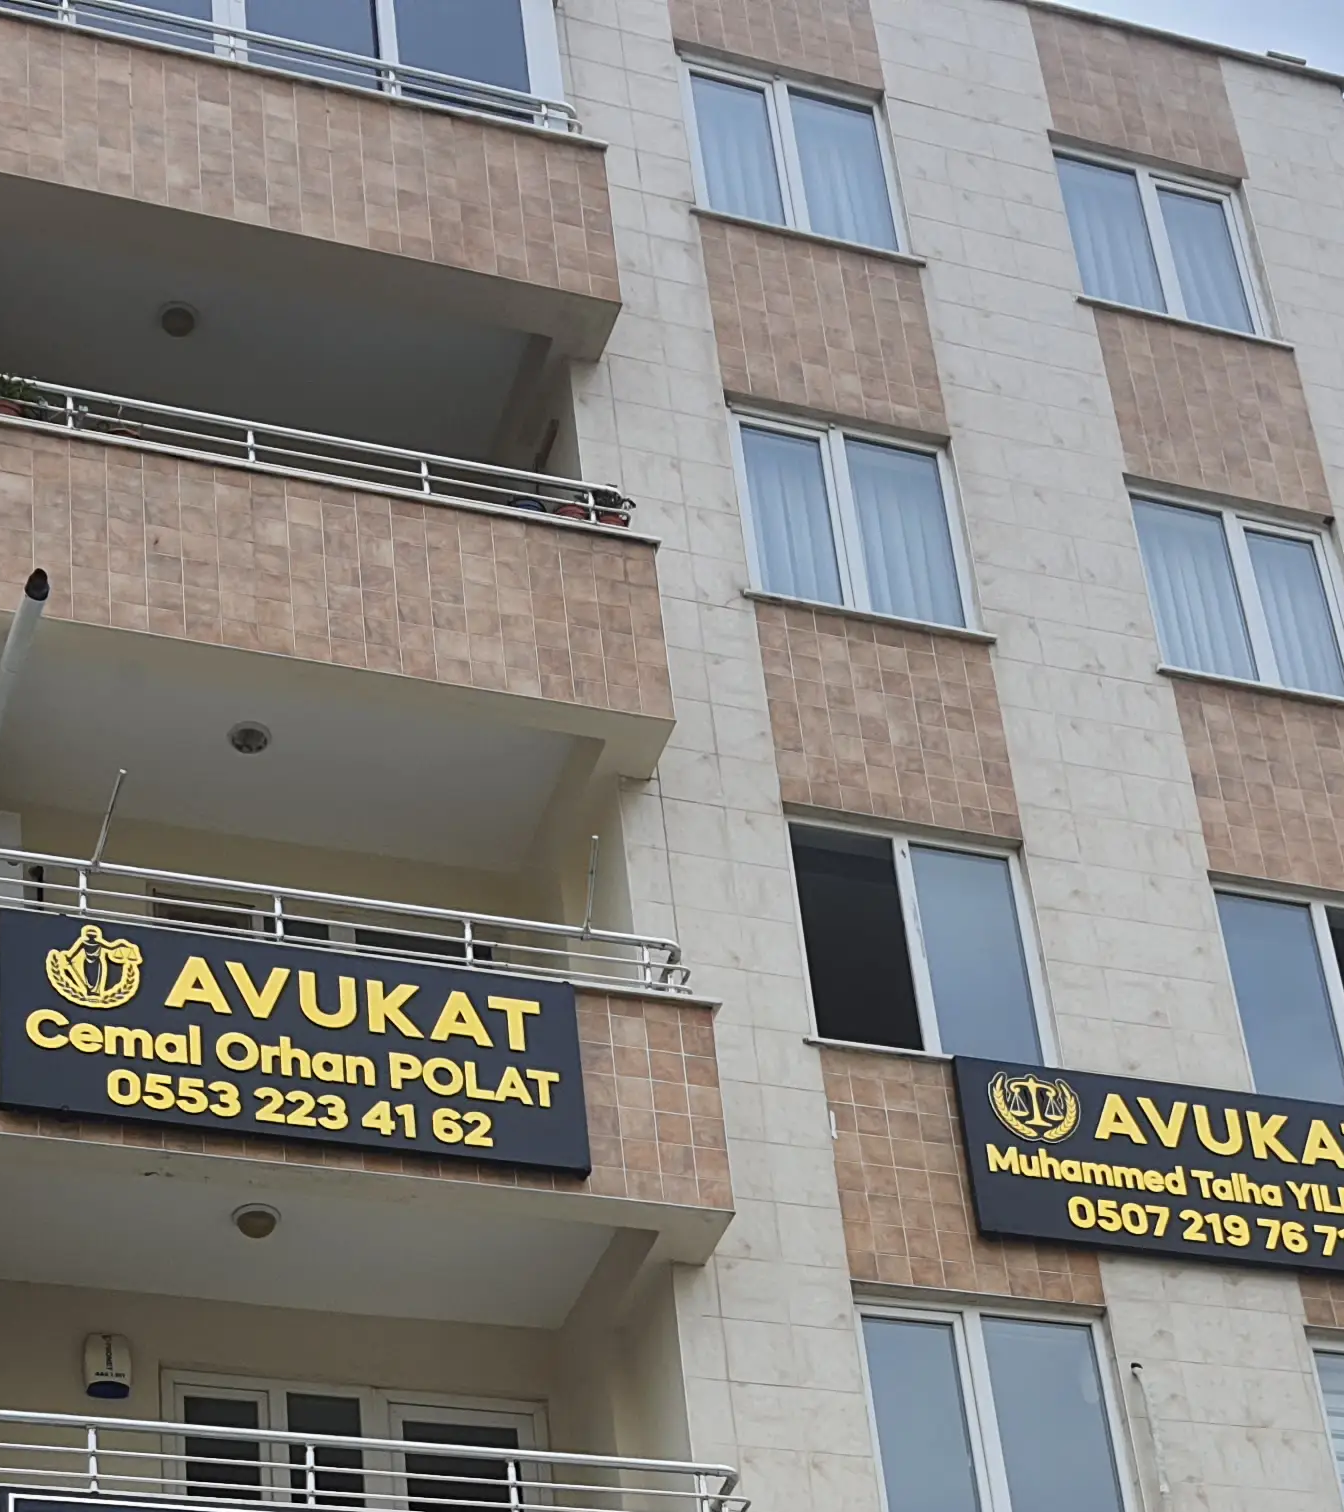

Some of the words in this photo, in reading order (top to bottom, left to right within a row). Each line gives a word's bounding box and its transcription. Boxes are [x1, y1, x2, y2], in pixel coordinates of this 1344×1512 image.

[164, 954, 541, 1052] AVUKAT
[25, 1009, 202, 1066] Cemal
[215, 1032, 376, 1088] Orhan
[389, 1052, 560, 1109] POLAT
[107, 1068, 242, 1117] 0553
[254, 1086, 350, 1131] 223
[362, 1101, 417, 1139] 41
[431, 1107, 494, 1148] 62
[986, 1143, 1186, 1196] Muhammed
[1191, 1169, 1283, 1208] Talha
[1068, 1195, 1171, 1238] 0507
[1182, 1209, 1251, 1248] 219
[1256, 1217, 1309, 1254] 76
